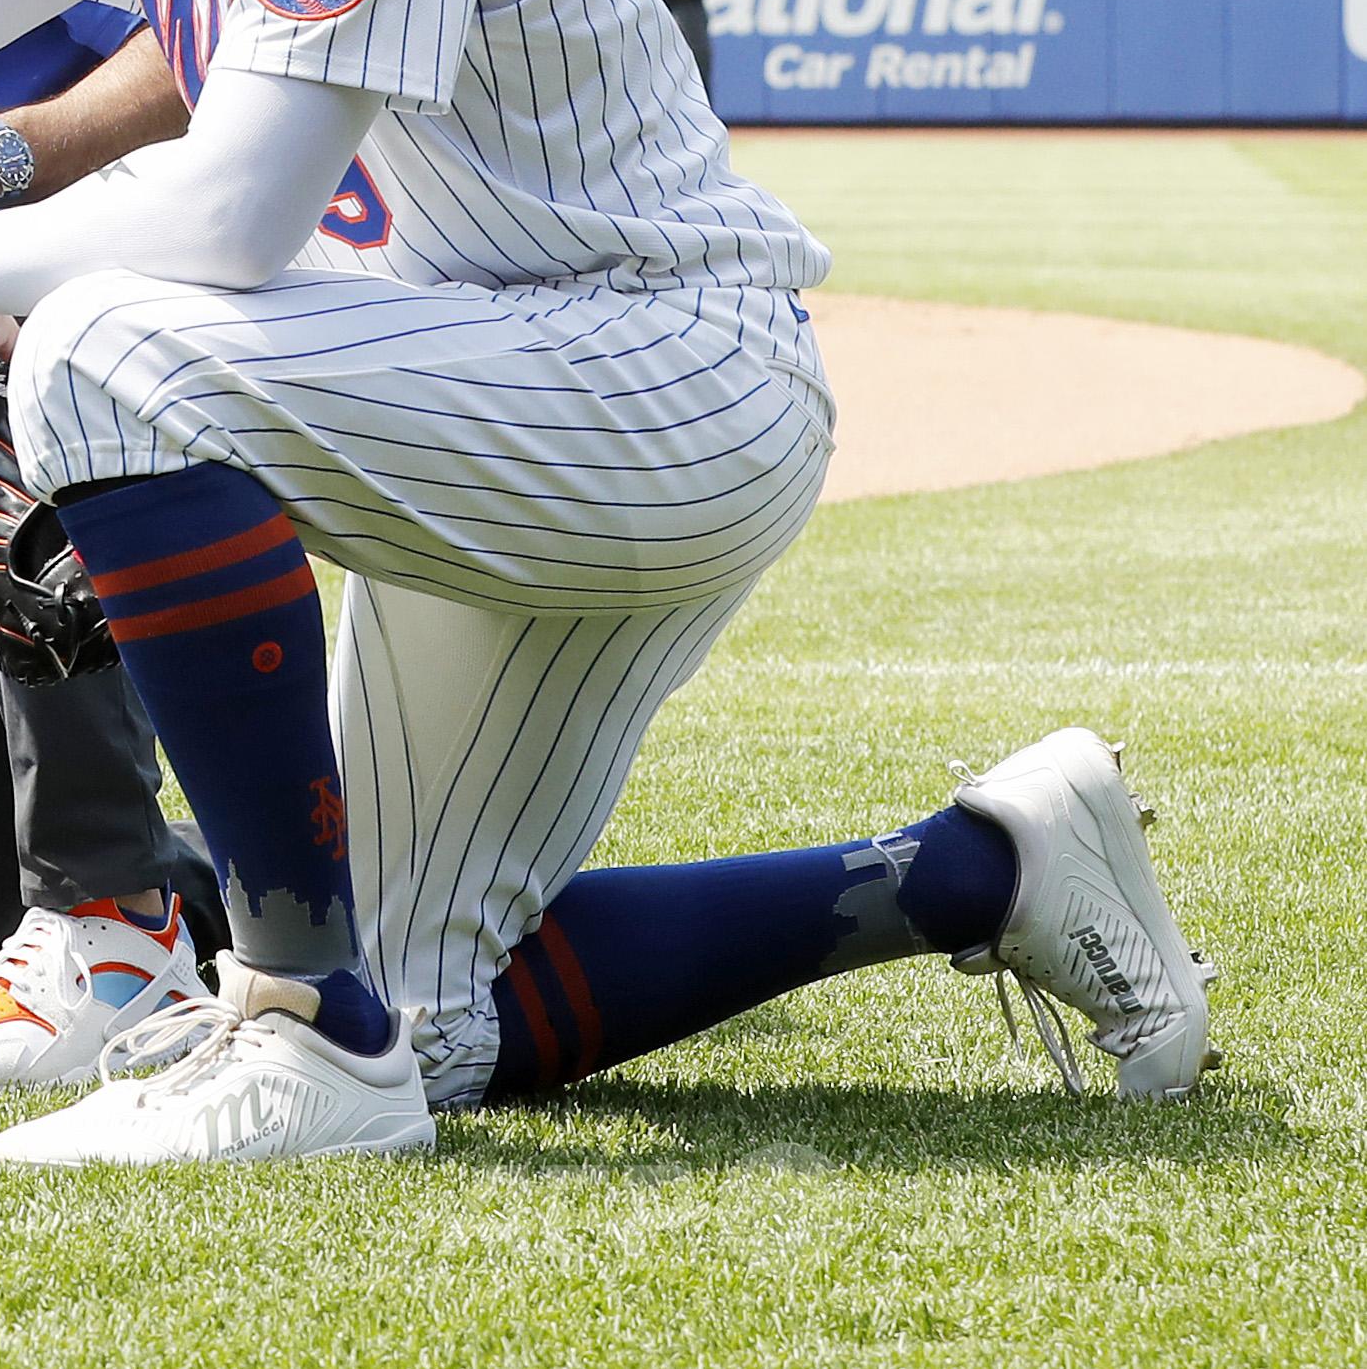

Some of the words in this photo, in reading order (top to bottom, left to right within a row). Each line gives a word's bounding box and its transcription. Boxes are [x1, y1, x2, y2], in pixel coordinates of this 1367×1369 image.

[763, 42, 855, 90] Car
[864, 41, 1038, 90] Rental
[1067, 924, 1145, 1015] marucci
[219, 1115, 285, 1158] marucci
